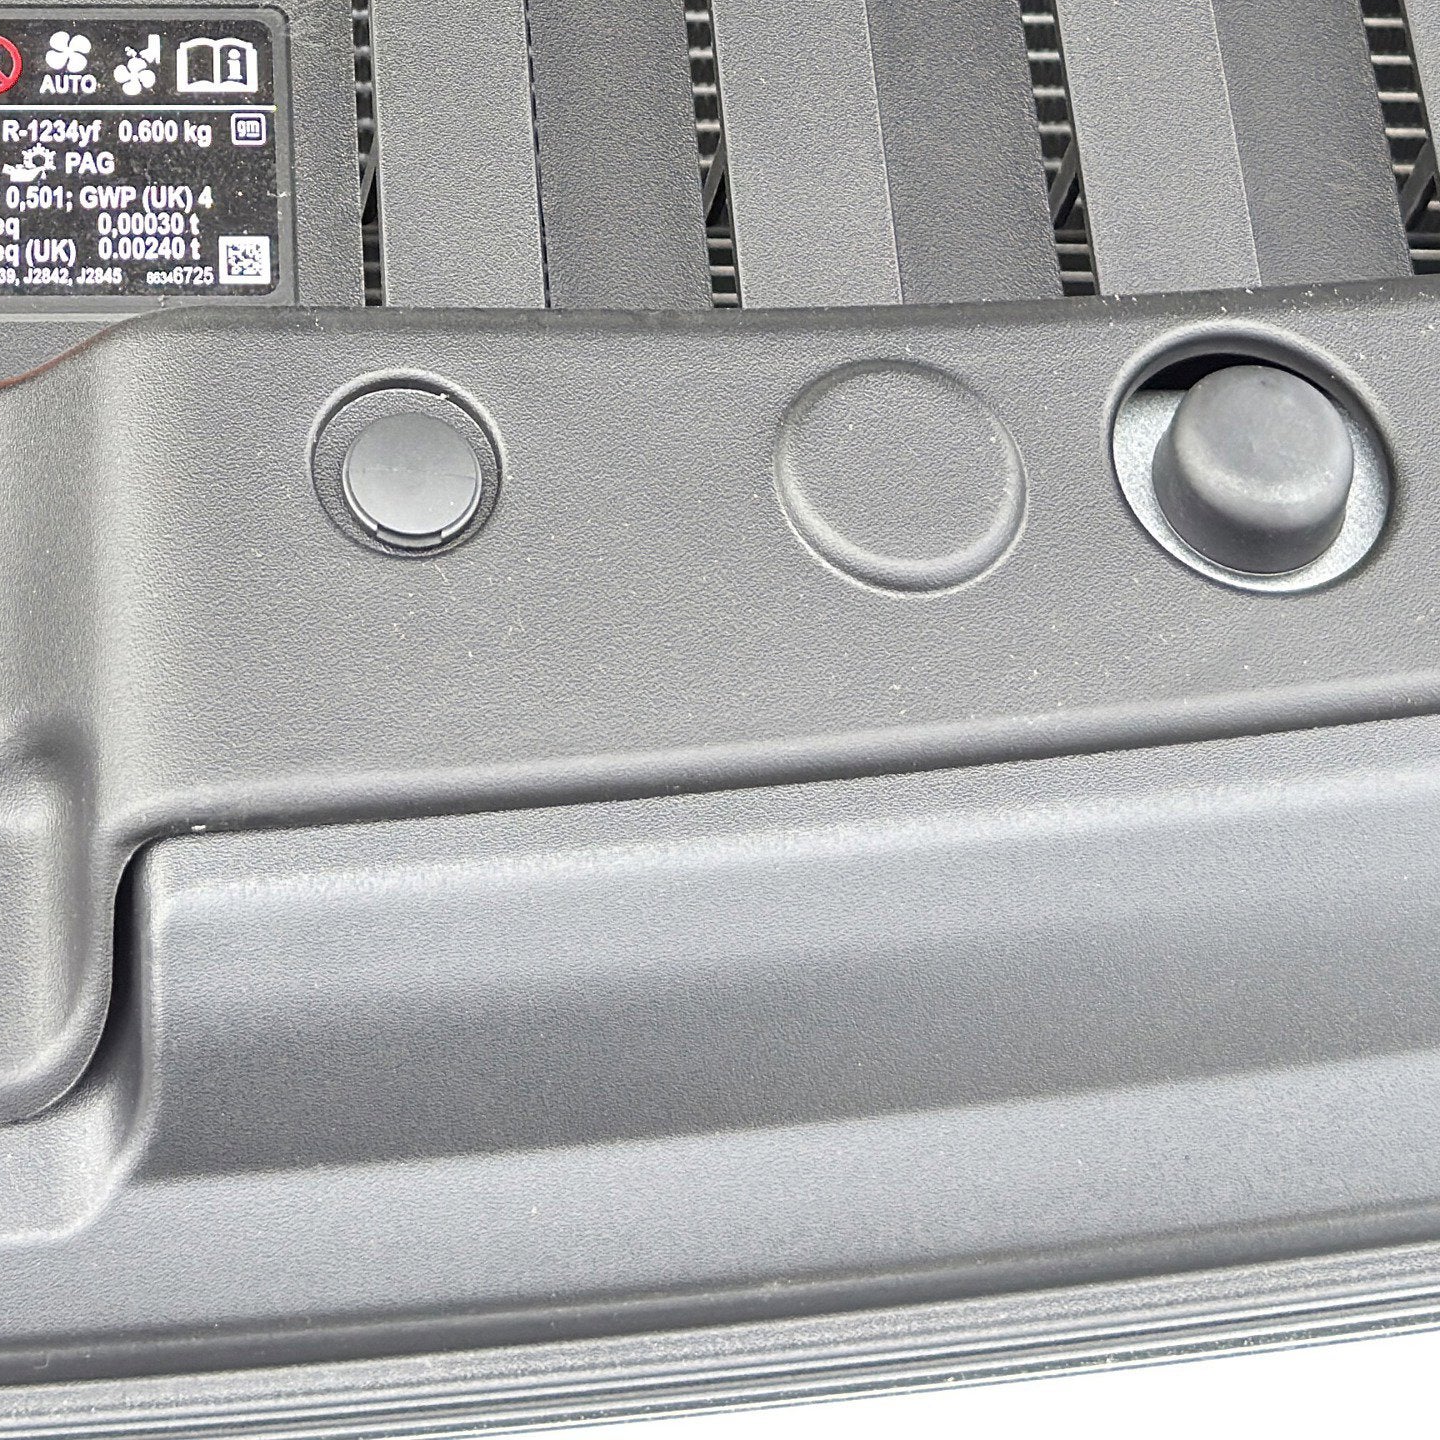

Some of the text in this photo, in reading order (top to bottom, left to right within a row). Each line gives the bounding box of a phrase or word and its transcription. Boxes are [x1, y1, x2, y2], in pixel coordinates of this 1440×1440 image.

[40, 74, 97, 94] AUTO
[2, 120, 212, 148] R-1234yf 0.600 kg
[65, 151, 115, 174] PAG
[5, 185, 73, 212] 0,501;
[79, 185, 137, 208] GWP
[142, 185, 194, 214] (UK)
[198, 185, 214, 209] 4
[98, 212, 184, 238] 0,00030
[189, 212, 200, 235] t
[25, 238, 77, 267] (UK)
[98, 236, 185, 260] 0.00240
[190, 237, 201, 260] t
[23, 267, 73, 286] J2842,
[77, 267, 122, 284] J2845
